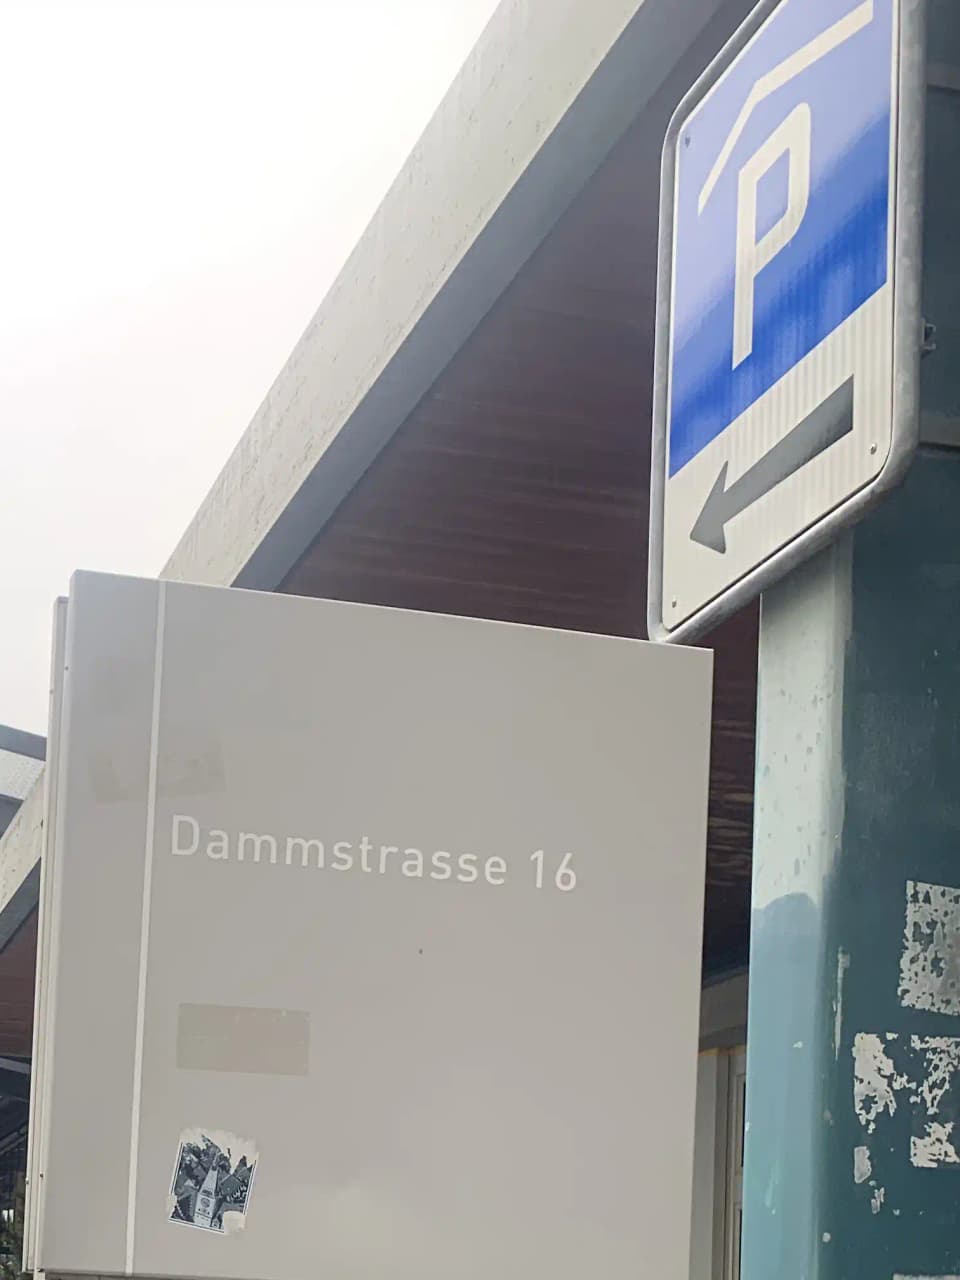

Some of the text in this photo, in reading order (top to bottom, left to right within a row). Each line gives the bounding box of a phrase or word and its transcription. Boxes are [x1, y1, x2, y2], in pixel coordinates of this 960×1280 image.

[732, 102, 810, 370] P
[170, 814, 577, 891] Dammstrasse 16
